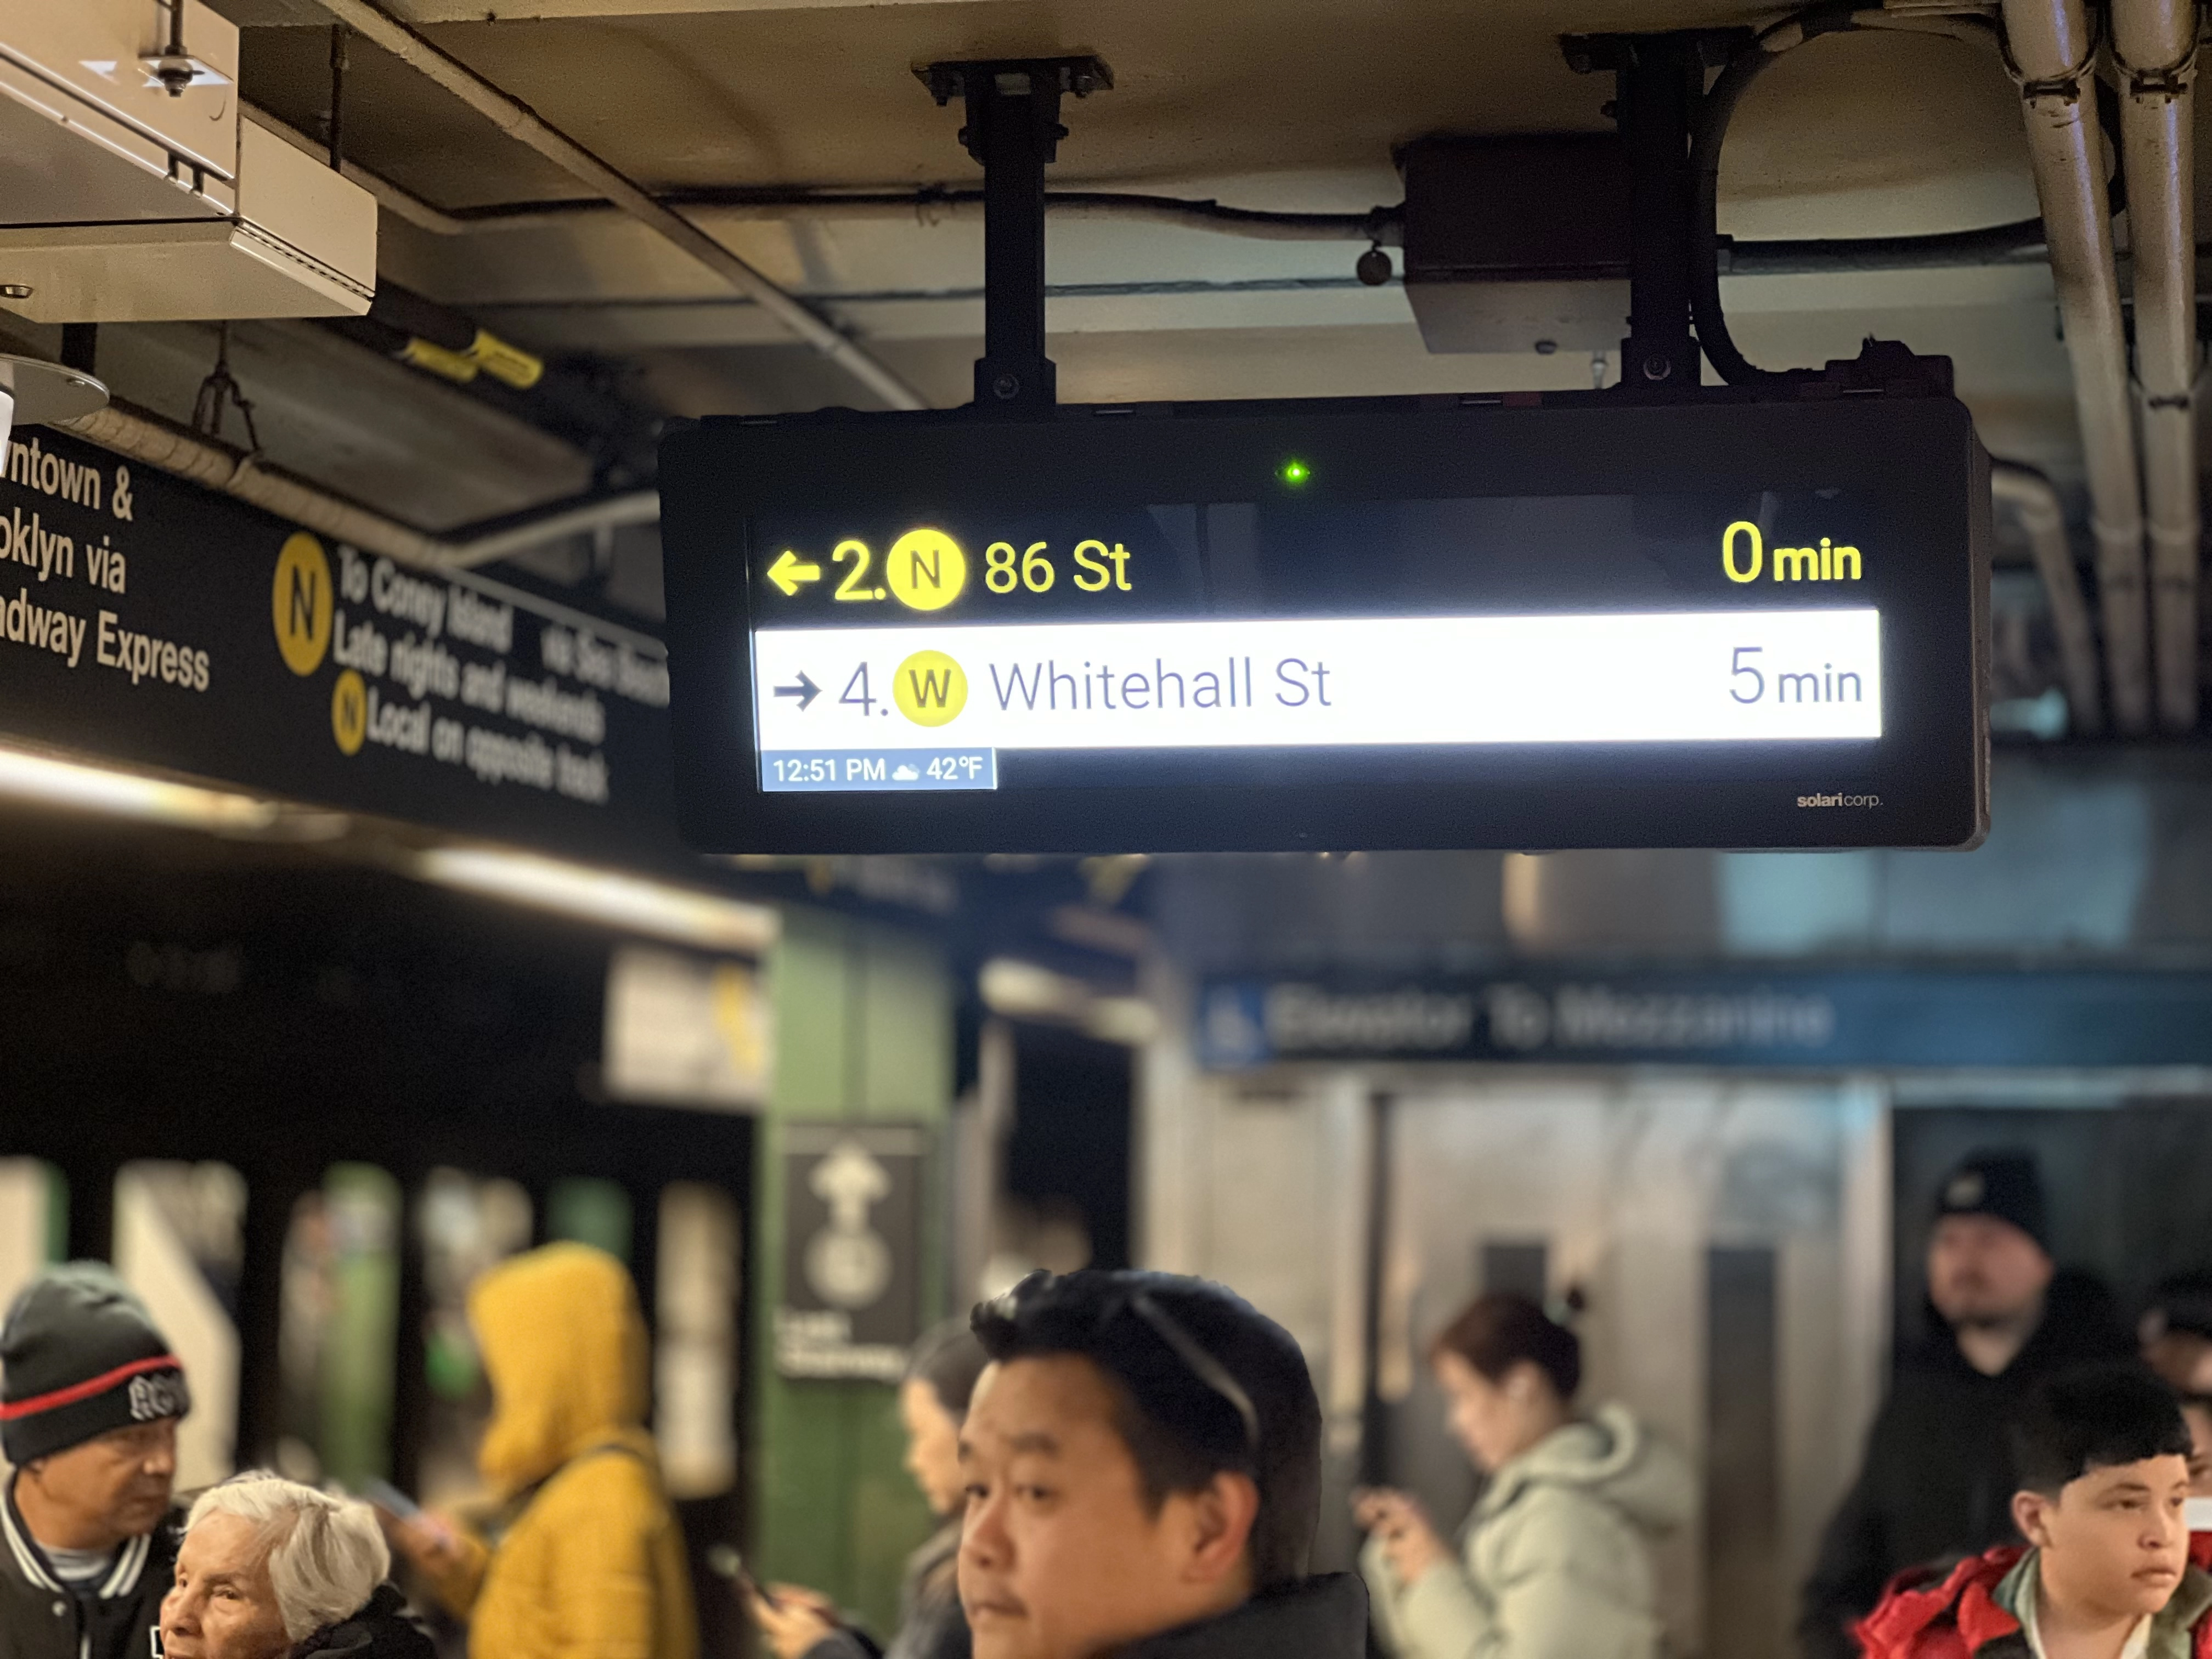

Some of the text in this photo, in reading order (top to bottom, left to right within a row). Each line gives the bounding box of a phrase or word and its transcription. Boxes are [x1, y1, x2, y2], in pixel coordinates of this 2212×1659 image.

[2, 438, 132, 521] ntown &
[86, 536, 126, 594] via
[338, 546, 368, 603] To
[832, 521, 1862, 601] 2. N 86 St 0 min
[290, 564, 315, 642] N
[97, 610, 210, 692] Express
[839, 646, 1863, 716] 4. W Whitehall St 5 min
[367, 687, 432, 755] Local
[774, 757, 983, 782] 12:51 PM 42°F
